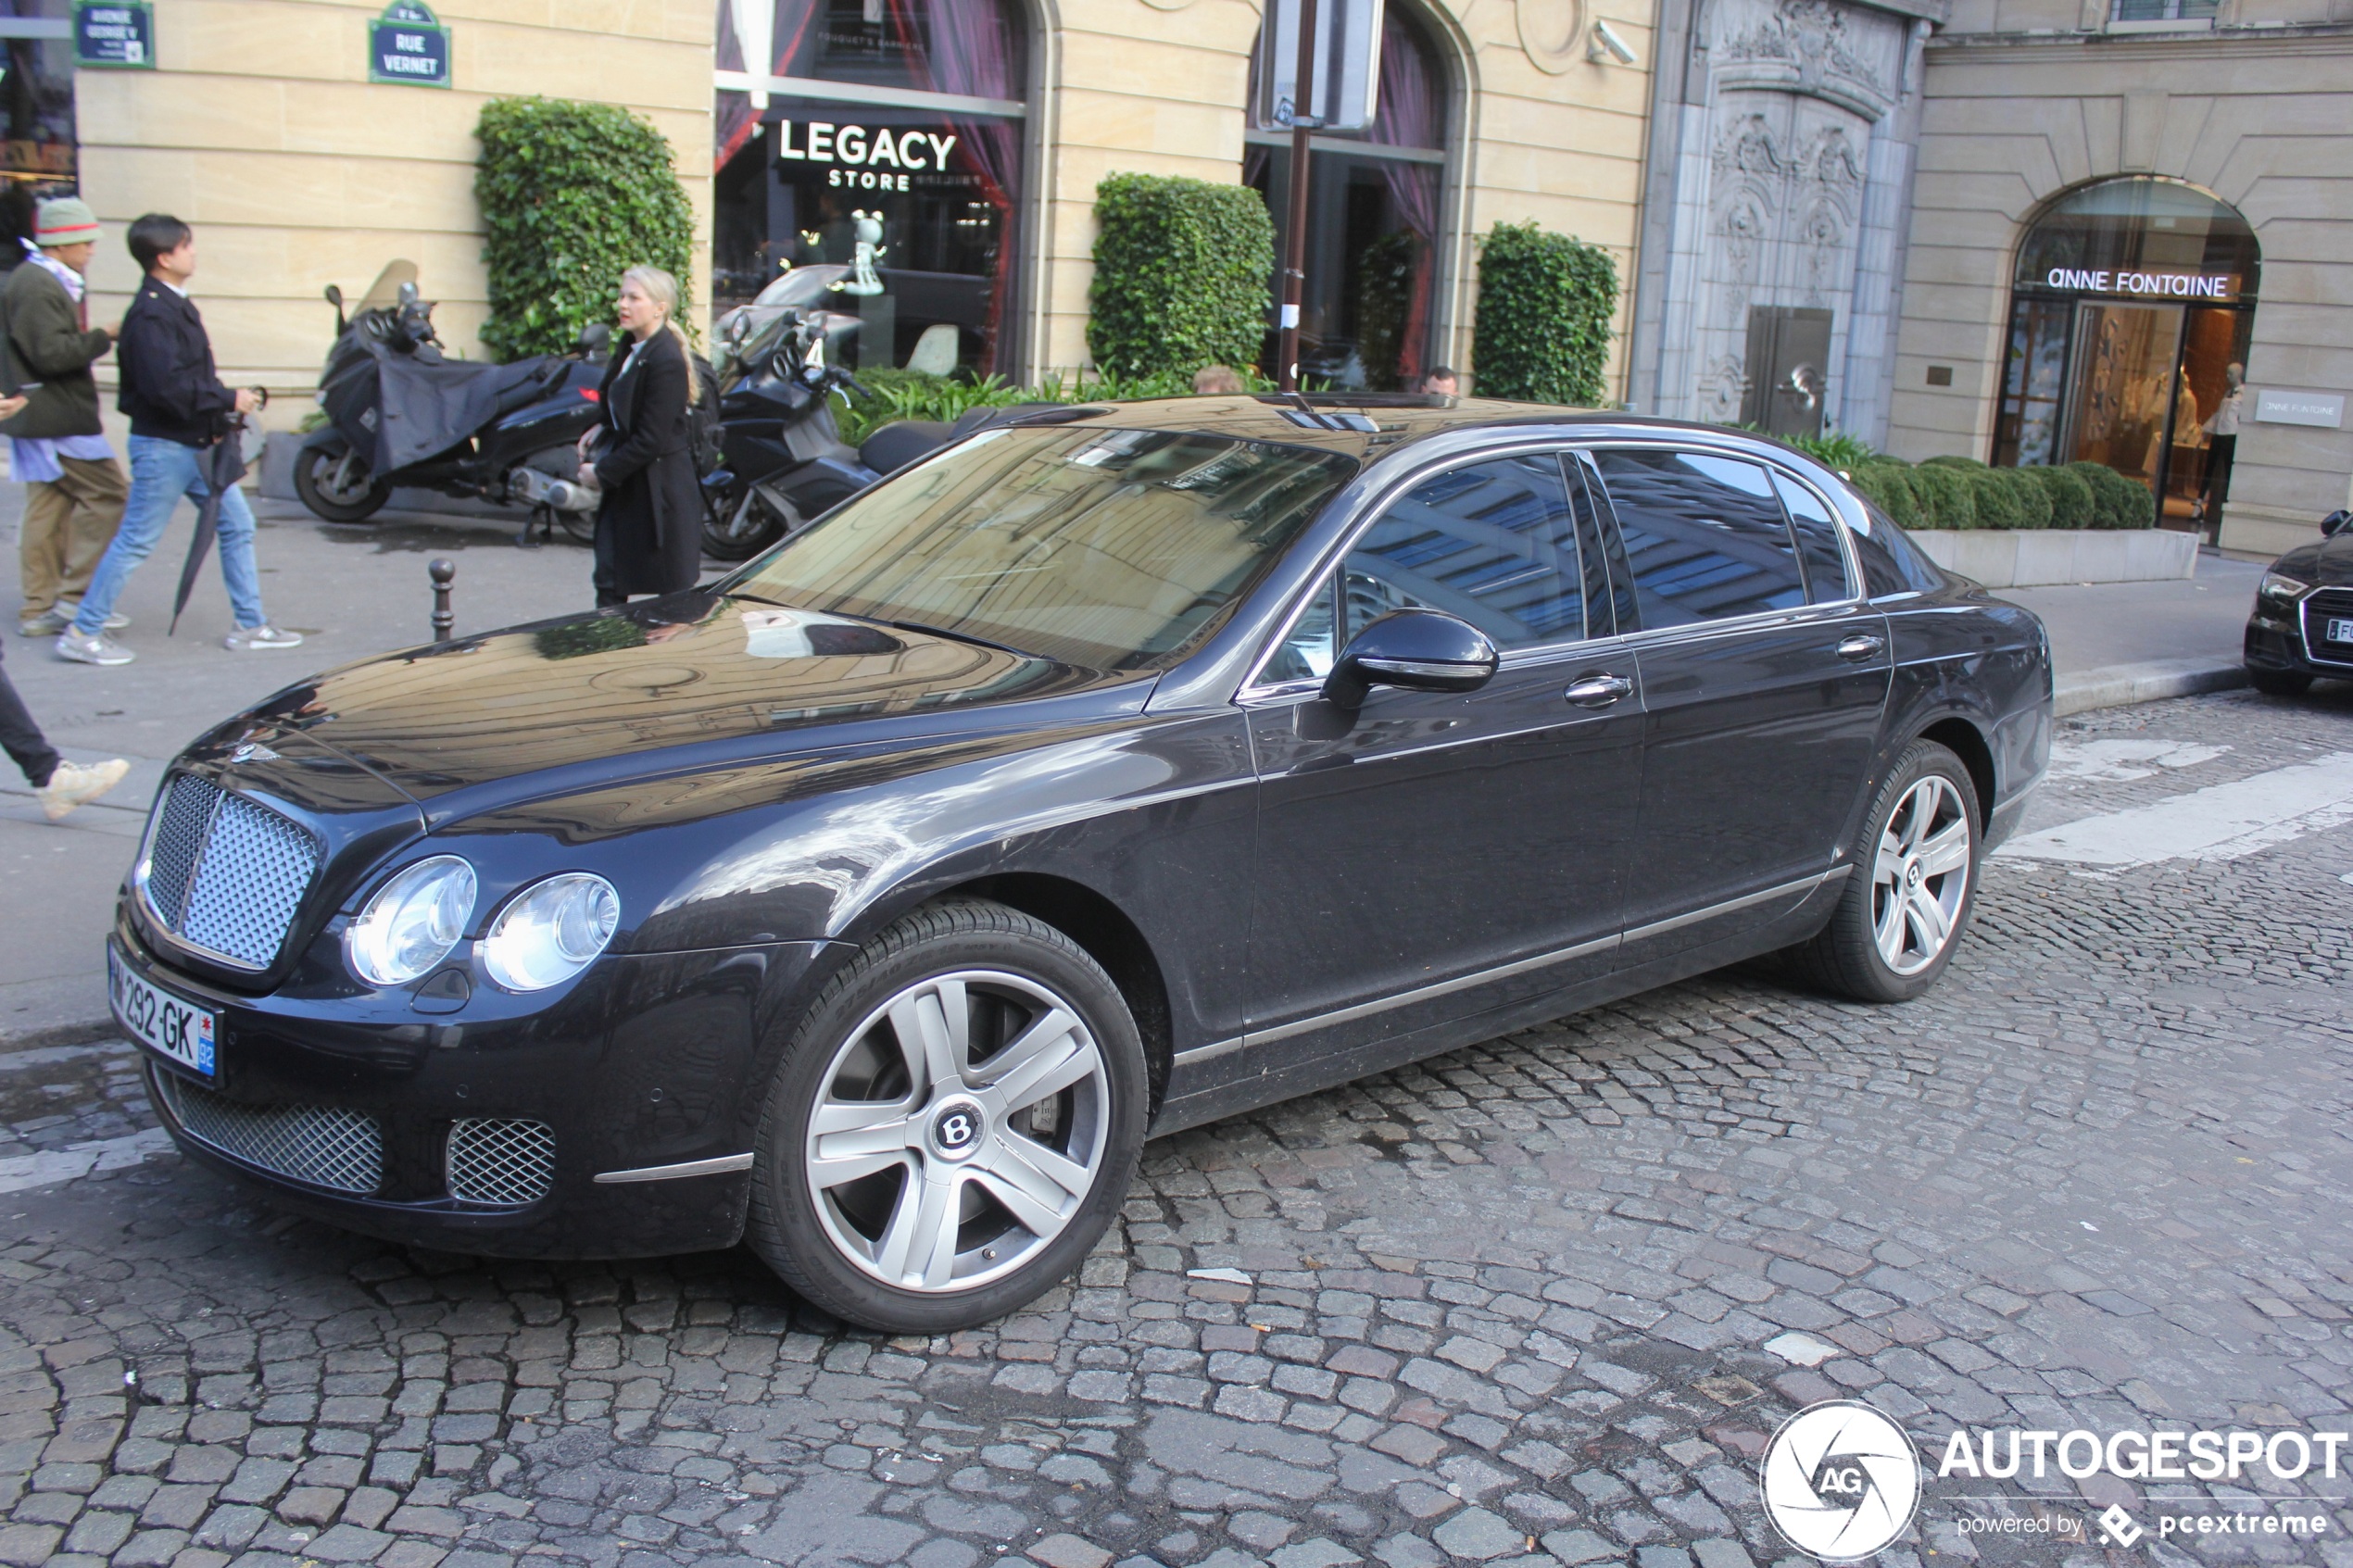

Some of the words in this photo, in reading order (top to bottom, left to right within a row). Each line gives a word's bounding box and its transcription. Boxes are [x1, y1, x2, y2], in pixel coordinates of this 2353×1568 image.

[396, 33, 426, 53] RUE
[383, 54, 439, 75] VERNET
[779, 119, 957, 172] LEGACY
[828, 169, 911, 192] STORE
[199, 1042, 214, 1068] 92
[942, 1114, 972, 1144] B
